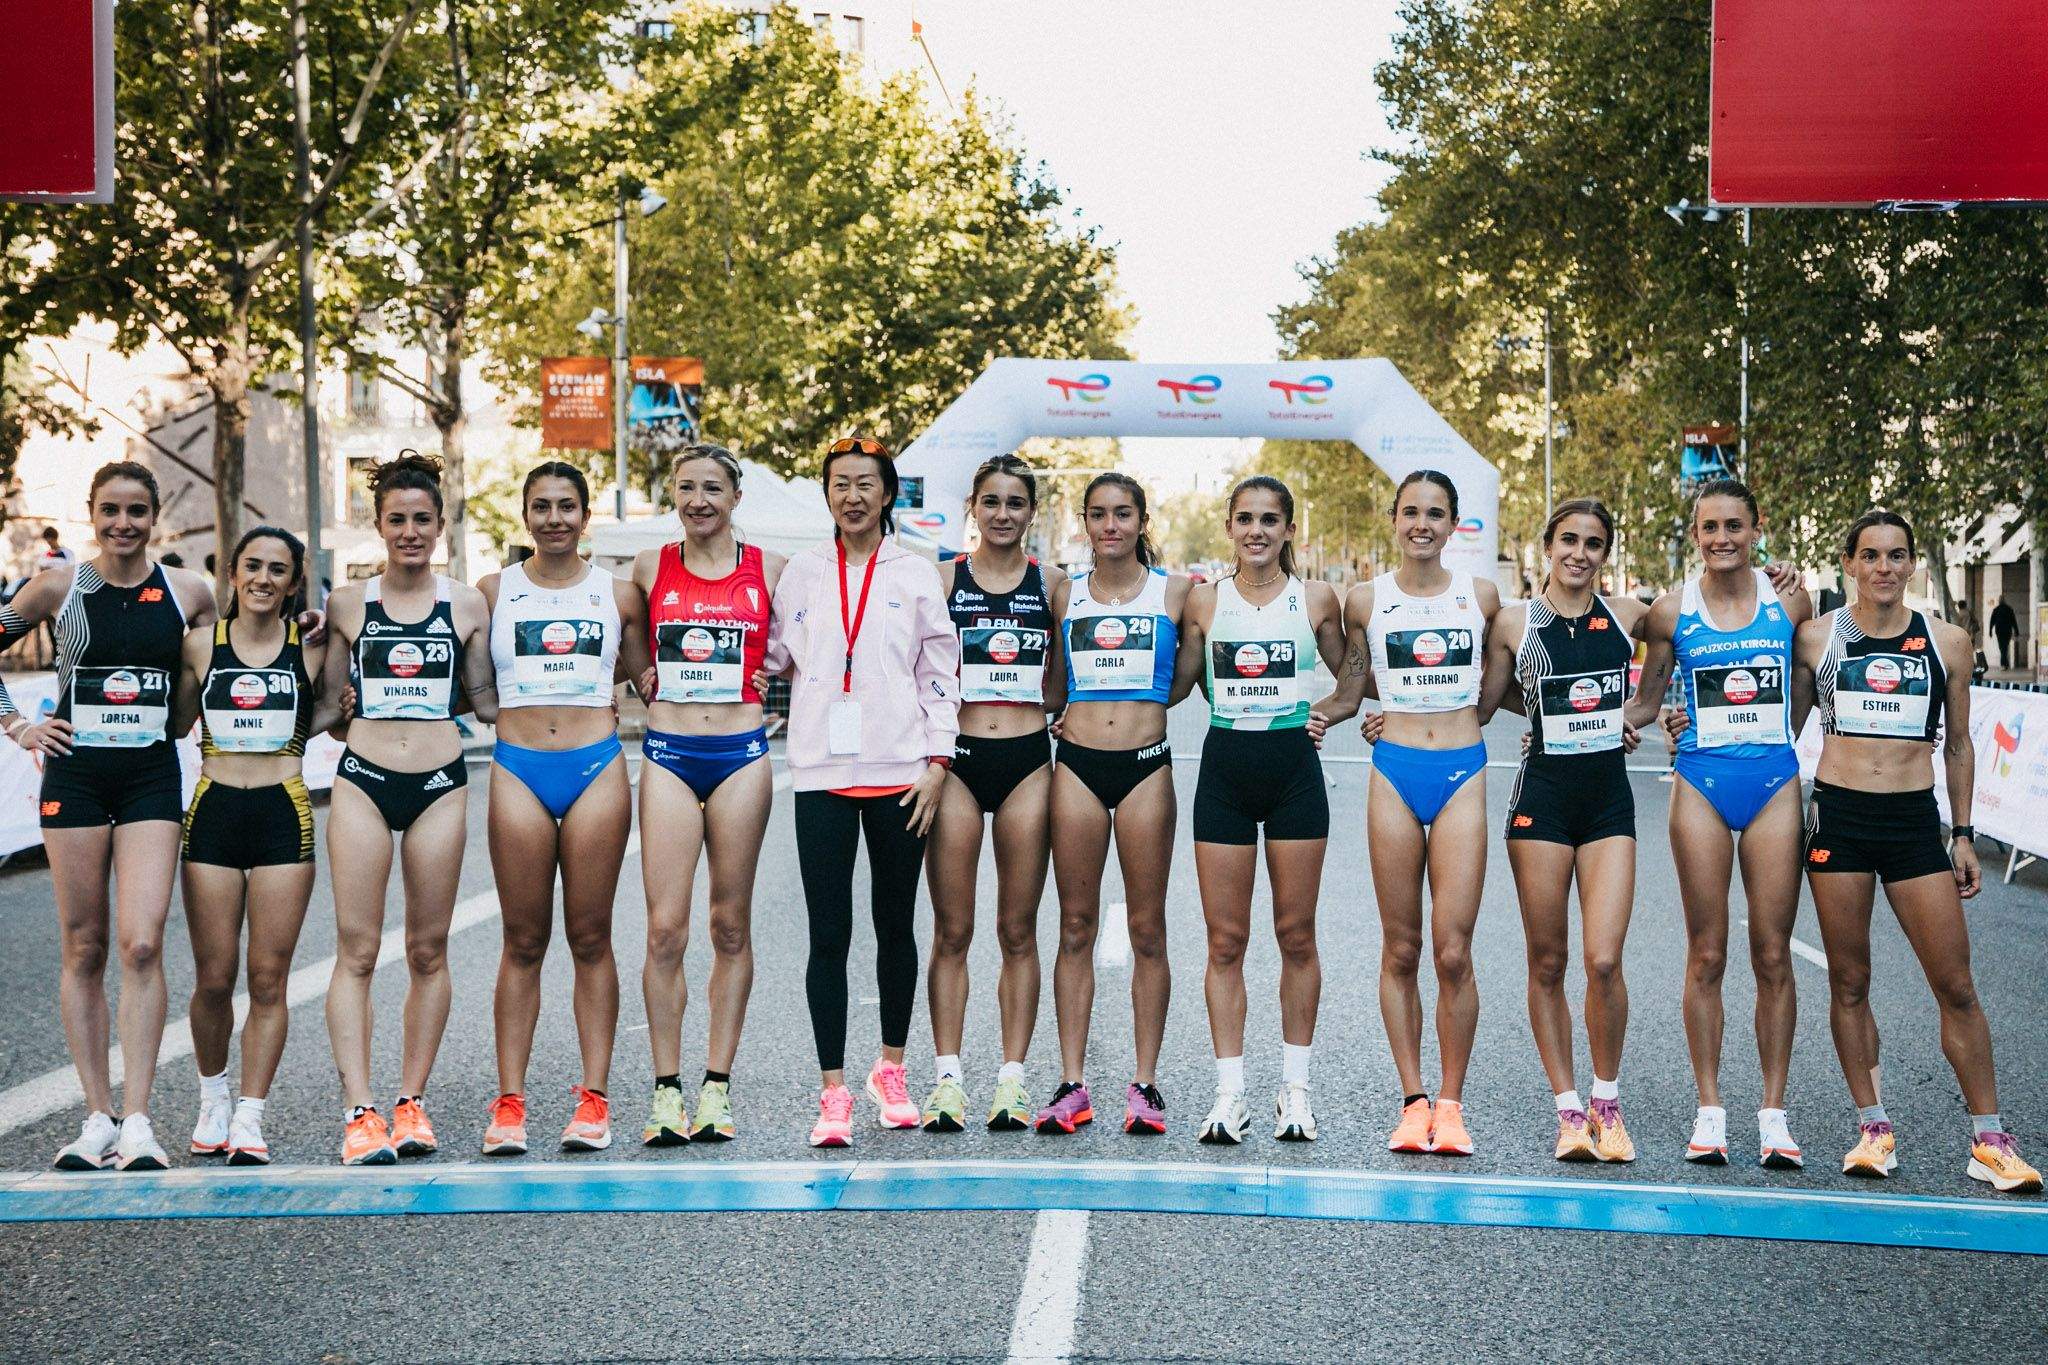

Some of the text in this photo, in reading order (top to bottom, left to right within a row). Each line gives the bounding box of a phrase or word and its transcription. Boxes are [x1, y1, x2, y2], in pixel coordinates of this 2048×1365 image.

[636, 368, 665, 380] ISLA
[1046, 408, 1111, 419] TotalEnergies
[1158, 410, 1221, 420] TotalEnergies
[1269, 410, 1333, 421] TotalEnergies
[1685, 434, 1708, 444] ISLA
[579, 621, 602, 640] 24
[1129, 618, 1151, 635] 29
[718, 630, 738, 648] 31
[1022, 633, 1043, 651] 22
[1448, 631, 1471, 650] 20
[426, 644, 449, 662] 23
[1270, 643, 1293, 662] 25
[1690, 642, 1740, 658] GIPUZKOA
[1095, 657, 1125, 668] CARLA
[680, 669, 712, 681] ISABEL
[1903, 660, 1925, 680] 34
[268, 674, 292, 694] 30
[989, 672, 1018, 683] LAURA
[1403, 673, 1459, 686] M. SERRANO
[1602, 674, 1621, 694] 26
[1759, 669, 1778, 688] 21
[1227, 685, 1279, 697] M. GARZZIA
[1862, 700, 1900, 713] ESTHER
[101, 712, 140, 724] LORENA
[233, 718, 263, 729] ANNIE
[1728, 713, 1758, 724] LOREA
[1568, 718, 1607, 732] DANIELA
[647, 738, 667, 748] ADM
[1137, 745, 1162, 760] NIKE
[424, 779, 454, 790] adidas
